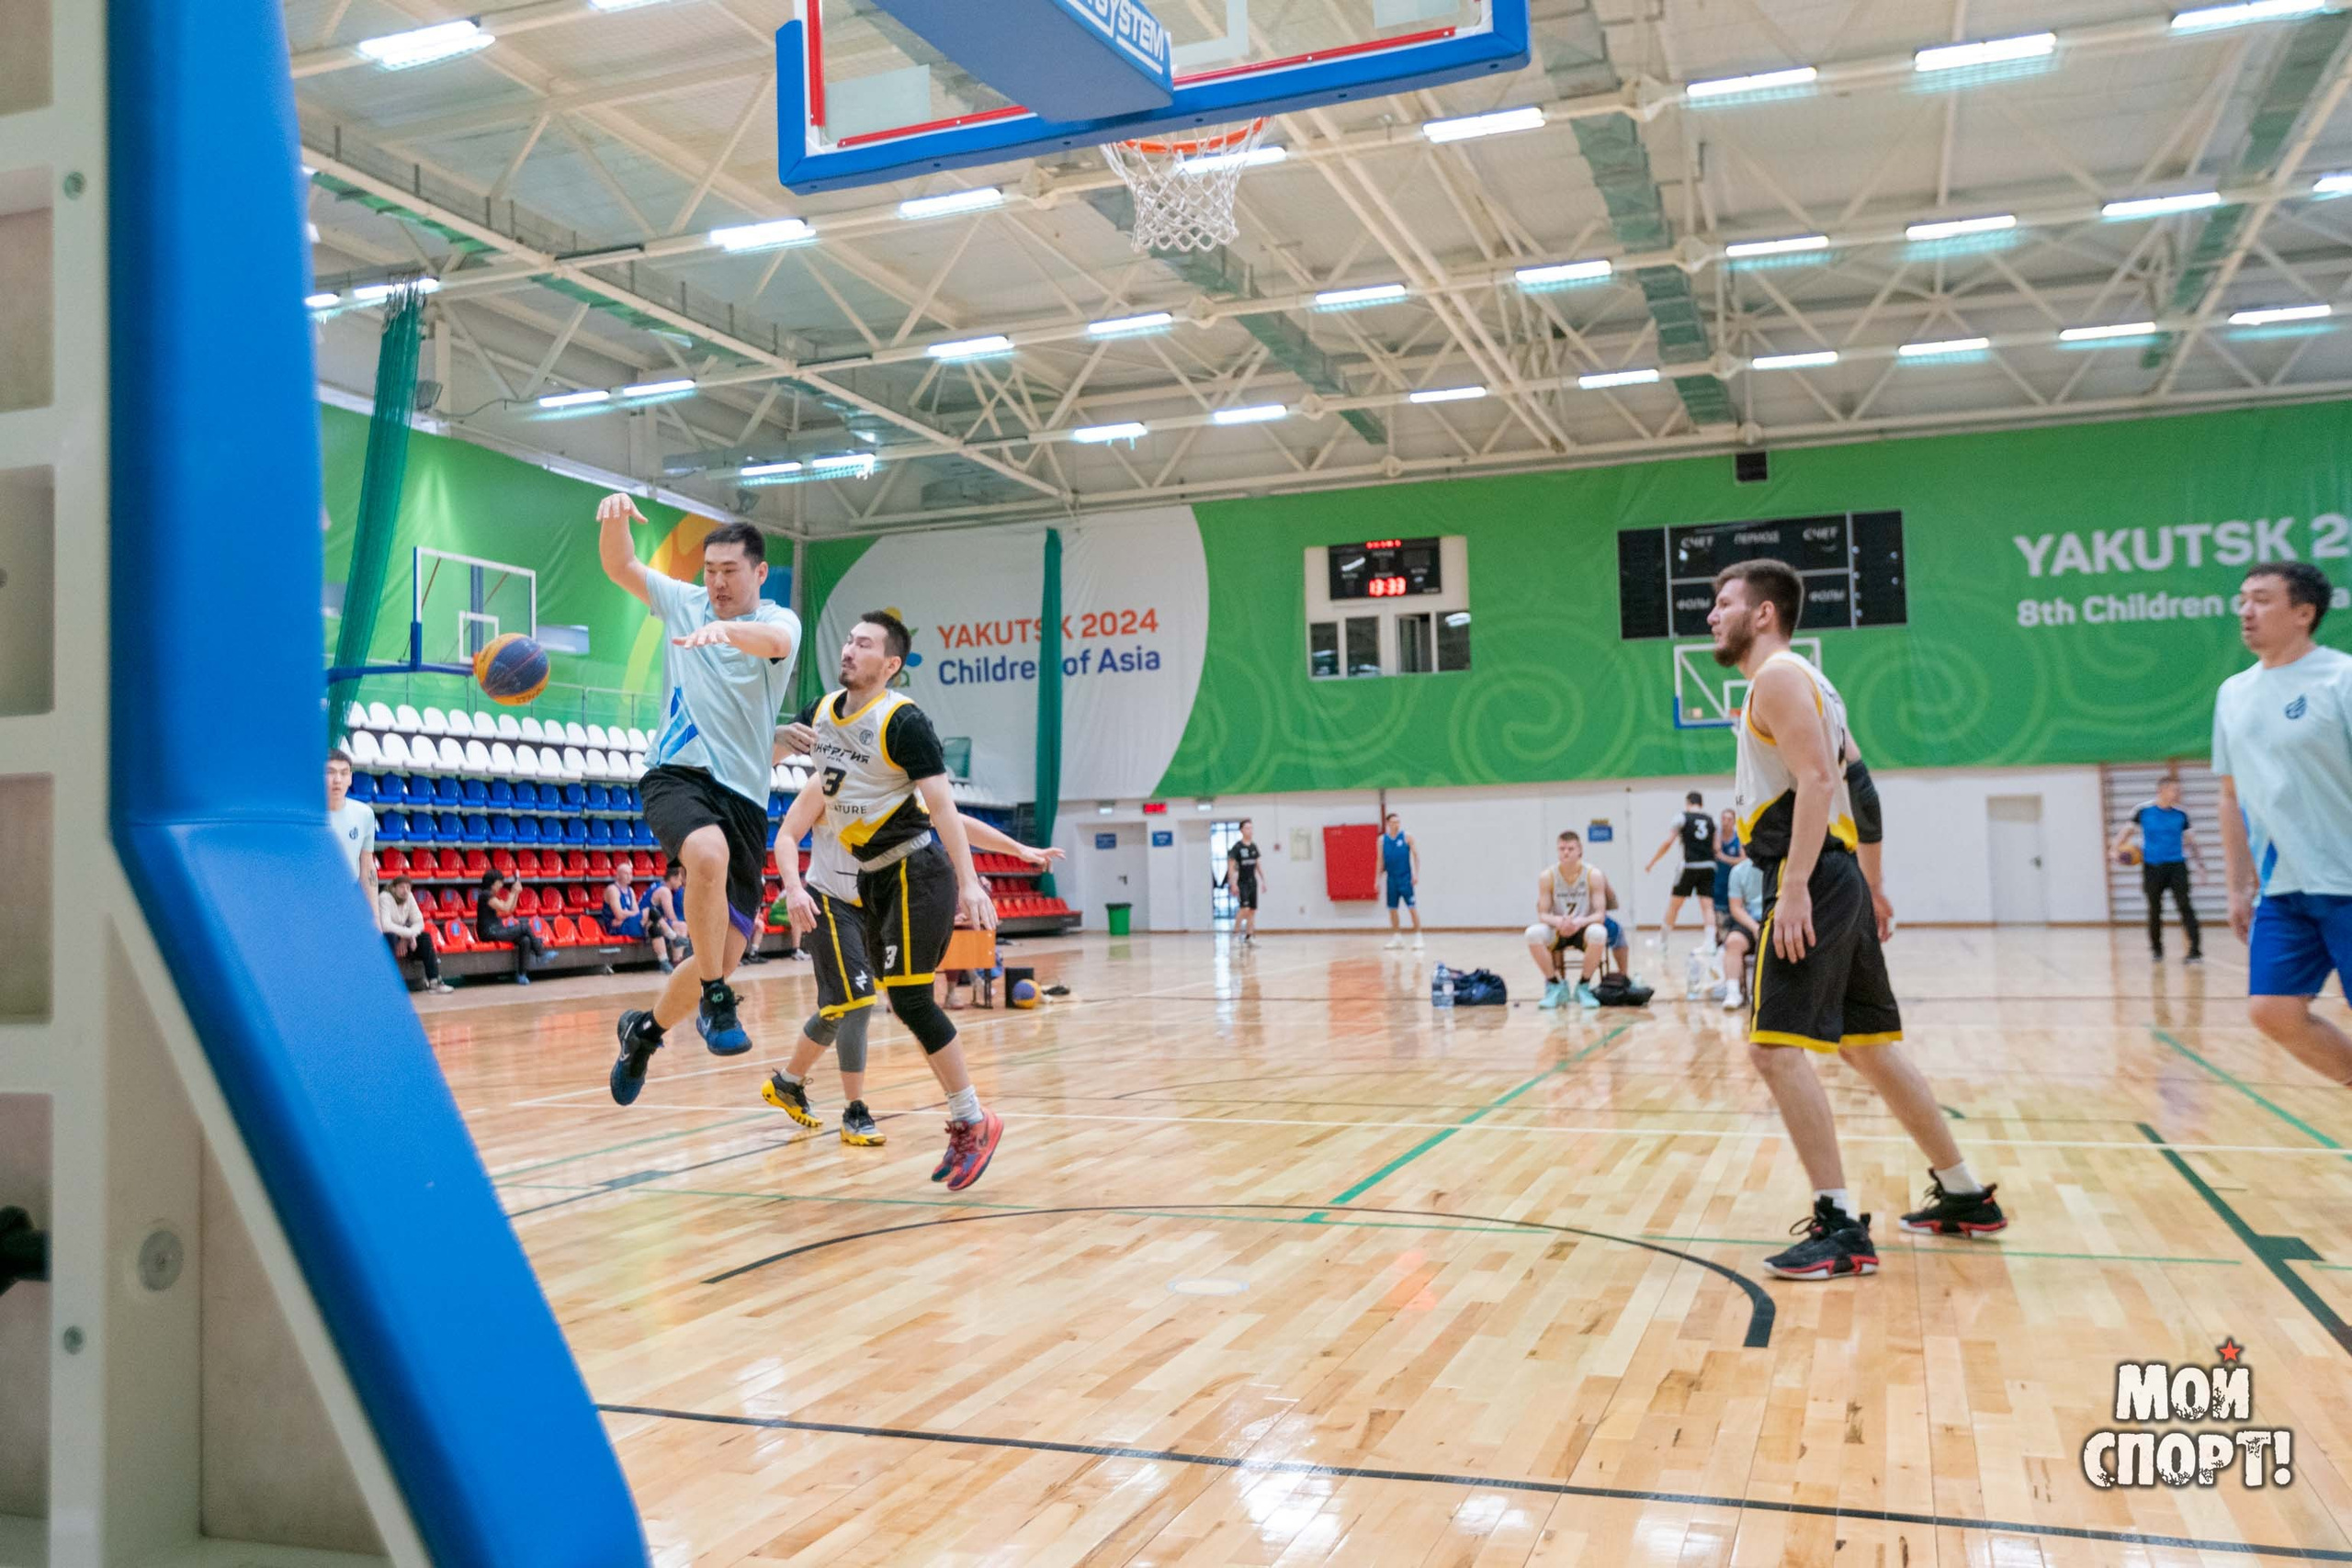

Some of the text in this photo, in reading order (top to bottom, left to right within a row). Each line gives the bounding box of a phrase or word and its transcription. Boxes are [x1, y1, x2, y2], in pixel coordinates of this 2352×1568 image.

[2013, 516, 2297, 578] YAKUTSK
[1080, 608, 1159, 639] 2024
[2017, 598, 2076, 627] 8th
[2083, 592, 2224, 624] Children
[938, 654, 1037, 686] Childre
[1062, 649, 1091, 677] of
[1097, 645, 1161, 674] Asia
[822, 766, 847, 797] 3
[1694, 818, 1709, 840] 3
[1566, 902, 1577, 916] 7
[884, 945, 898, 970] 3
